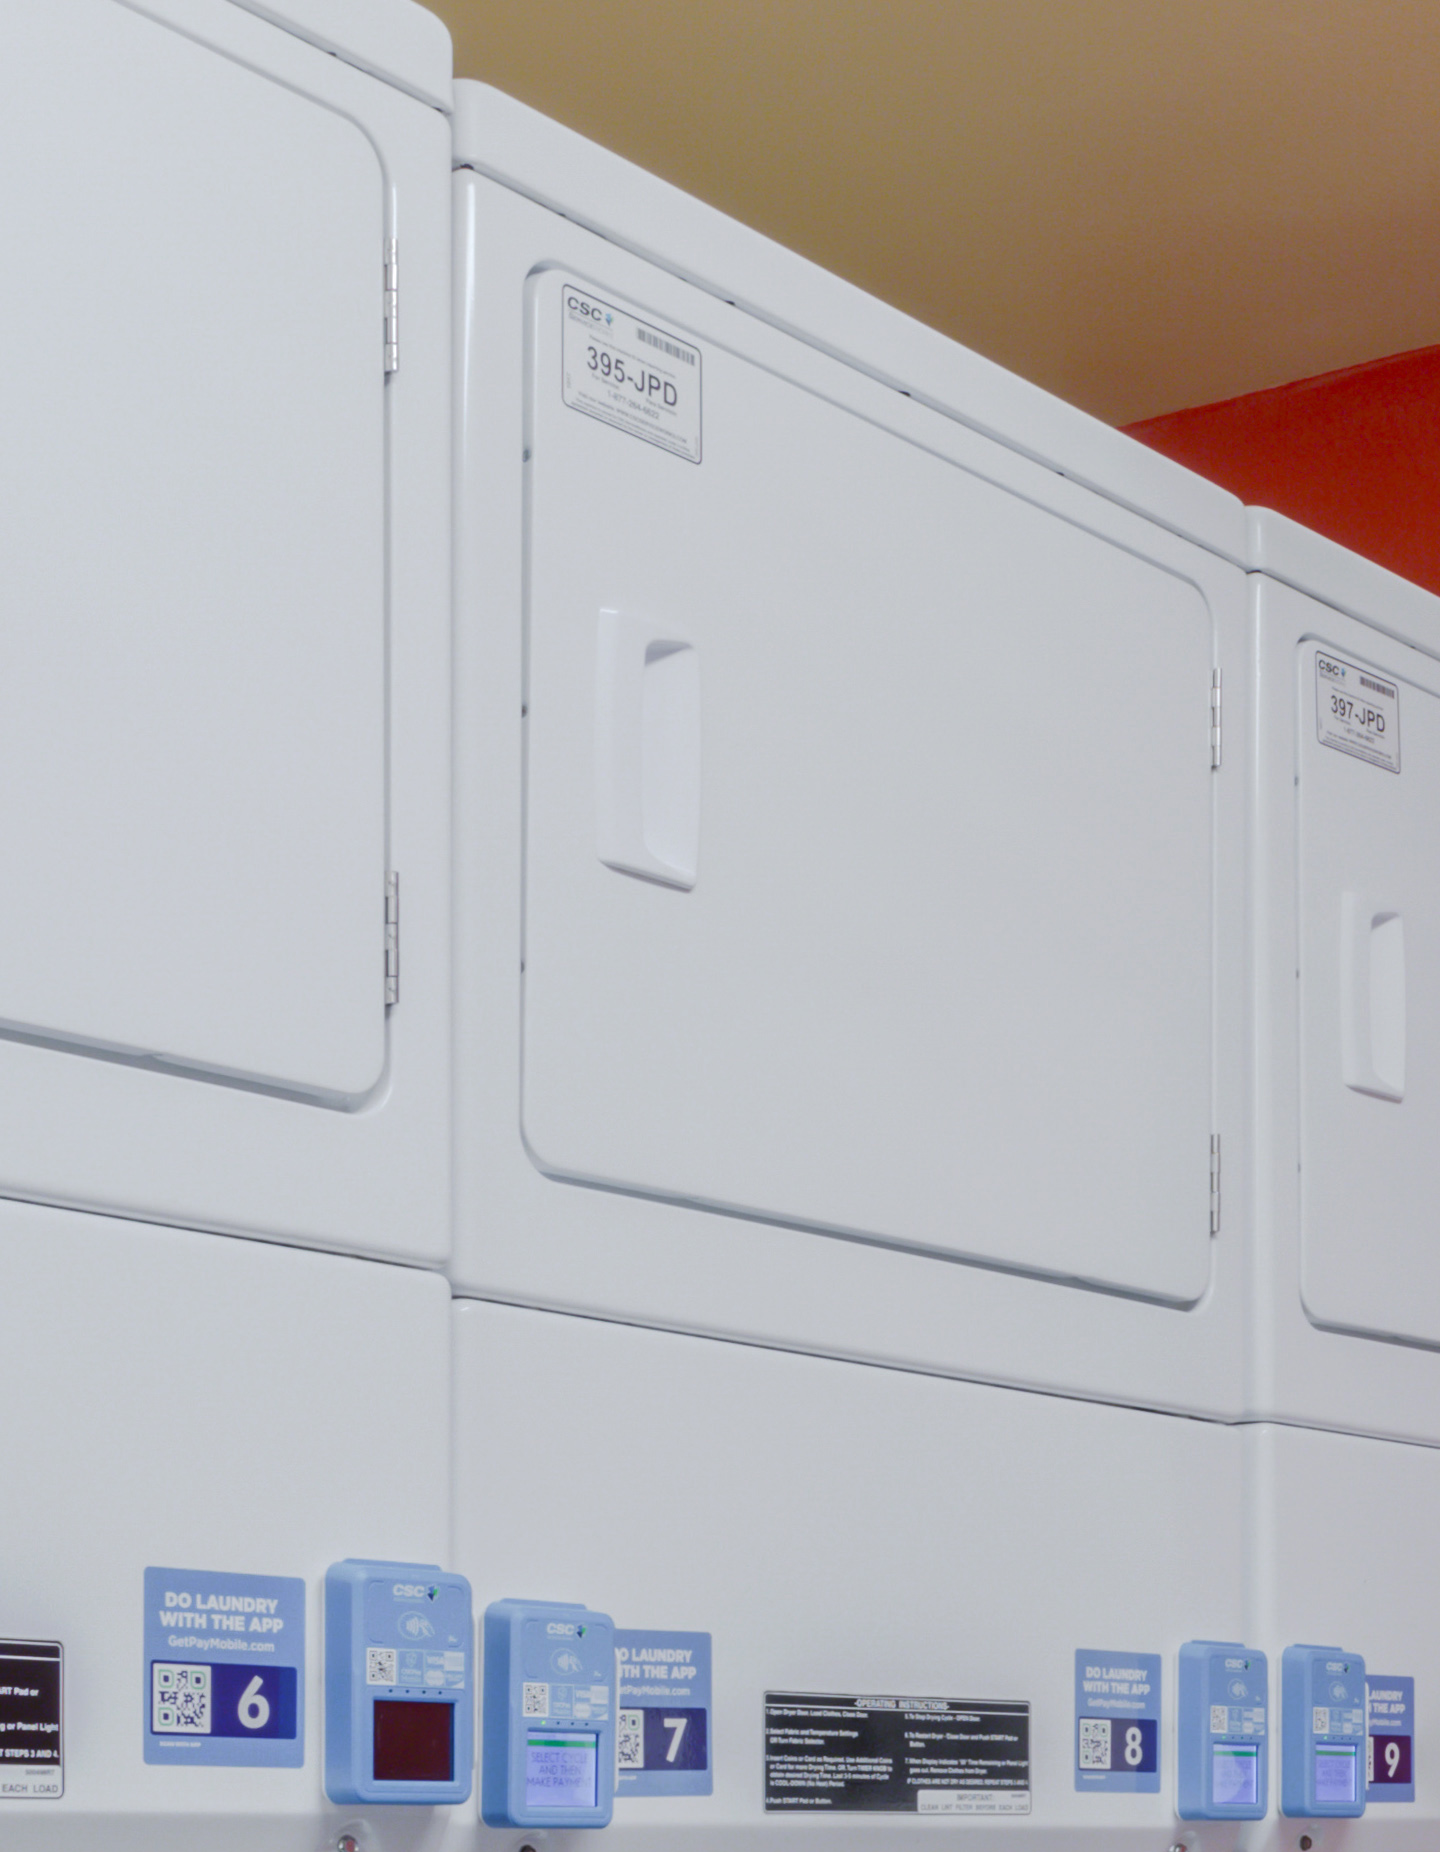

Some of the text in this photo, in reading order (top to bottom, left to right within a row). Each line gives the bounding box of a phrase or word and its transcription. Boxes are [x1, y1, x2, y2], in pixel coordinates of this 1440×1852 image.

[567, 297, 603, 321] CSC
[587, 346, 678, 407] 395-JPD
[1319, 659, 1339, 676] CSC
[1330, 695, 1385, 732] 397-JPD
[393, 1584, 425, 1597] CSC
[164, 1591, 278, 1615] DO LAUNDRY
[159, 1611, 284, 1632] WITH THE APP
[547, 1624, 574, 1635] CSC
[167, 1635, 275, 1651] GetPayMobile.com
[631, 1648, 692, 1663] LAUNDRY
[1225, 1658, 1243, 1669] CSC
[1326, 1662, 1343, 1672] CSC
[619, 1665, 696, 1679] ITH THE APP
[1086, 1667, 1148, 1681] DO LAUNDRY
[1083, 1681, 1150, 1695] WITH THE APP
[237, 1675, 270, 1729] 6
[1373, 1703, 1406, 1714] THE APP
[663, 1718, 687, 1762] 7
[1124, 1726, 1142, 1766] 8
[531, 1752, 560, 1762] SELECT
[1384, 1742, 1400, 1778] 9
[539, 1765, 581, 1775] AND THEN
[1, 1783, 28, 1792] EACH
[32, 1784, 58, 1793] LOAD
[527, 1778, 551, 1787] MAKE
